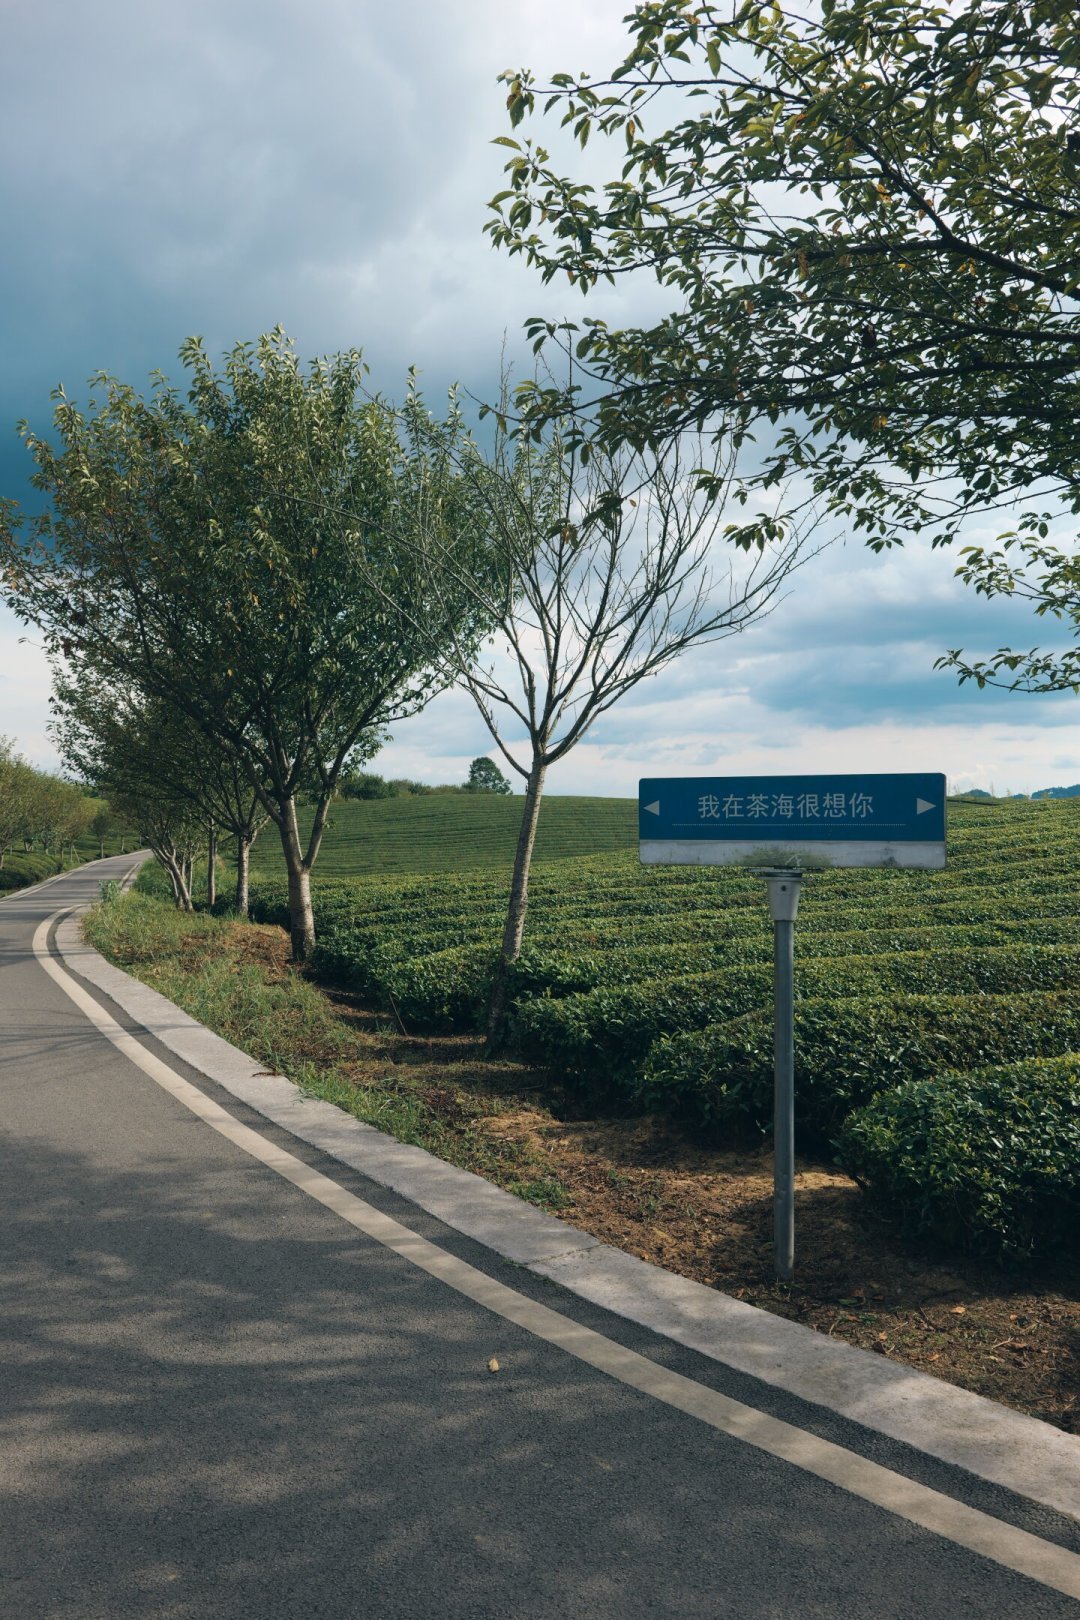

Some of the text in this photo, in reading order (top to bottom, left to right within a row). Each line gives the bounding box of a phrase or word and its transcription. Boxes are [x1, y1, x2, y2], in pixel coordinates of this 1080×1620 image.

[697, 792, 874, 819] 我在茶海很想你
